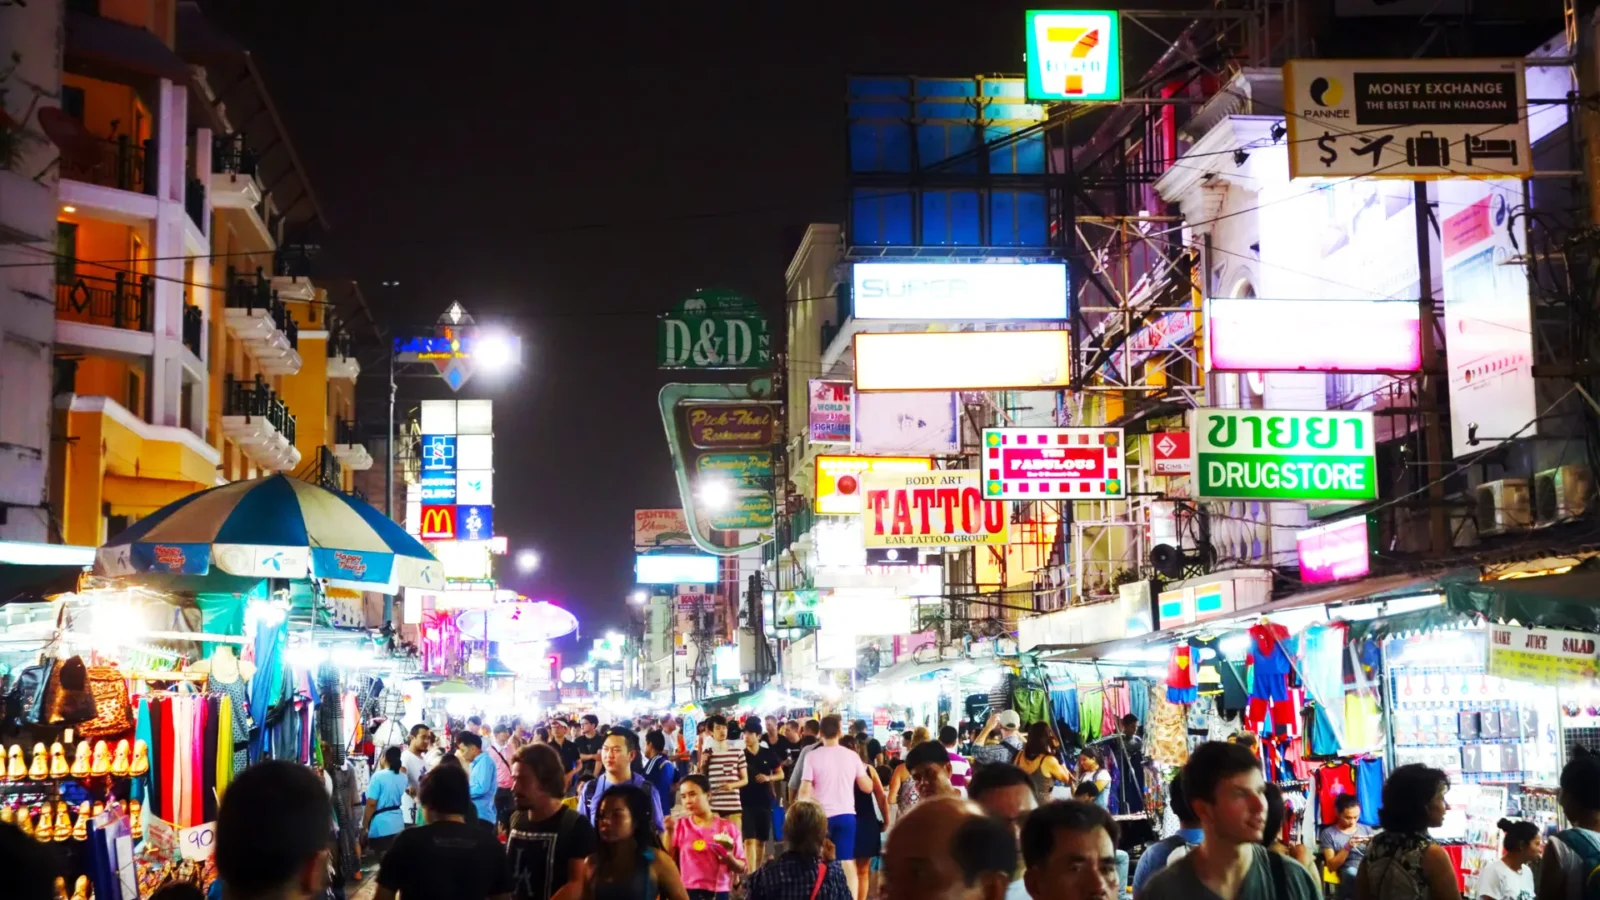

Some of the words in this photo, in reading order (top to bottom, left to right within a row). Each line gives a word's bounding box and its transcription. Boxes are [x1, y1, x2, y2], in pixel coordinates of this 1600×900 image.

[1368, 83, 1421, 94] MONEY
[1426, 83, 1504, 94] EXCHANGE
[1366, 101, 1385, 109] THE
[1387, 101, 1410, 109] BEST
[1412, 101, 1437, 109] RATE
[1440, 101, 1451, 109] IN
[1453, 101, 1507, 110] KHAOSAN
[1303, 109, 1350, 119] PANNEE
[663, 318, 752, 366] D&D
[758, 319, 771, 363] INN
[817, 403, 843, 411] WORLD
[1207, 414, 1364, 449] ขายยา
[1010, 459, 1096, 470] FABULOUS
[905, 476, 936, 485] BODY
[940, 476, 964, 485] ART
[1208, 461, 1366, 490] DRUGSTORE
[885, 536, 906, 544] EAK
[907, 535, 951, 544] TATTOO
[953, 534, 989, 543] GROUP
[334, 551, 362, 564] Happy
[681, 595, 711, 604] KAWN
[1525, 633, 1548, 650] JUICE
[1562, 637, 1596, 655] SALAD
[188, 829, 214, 849] 90
